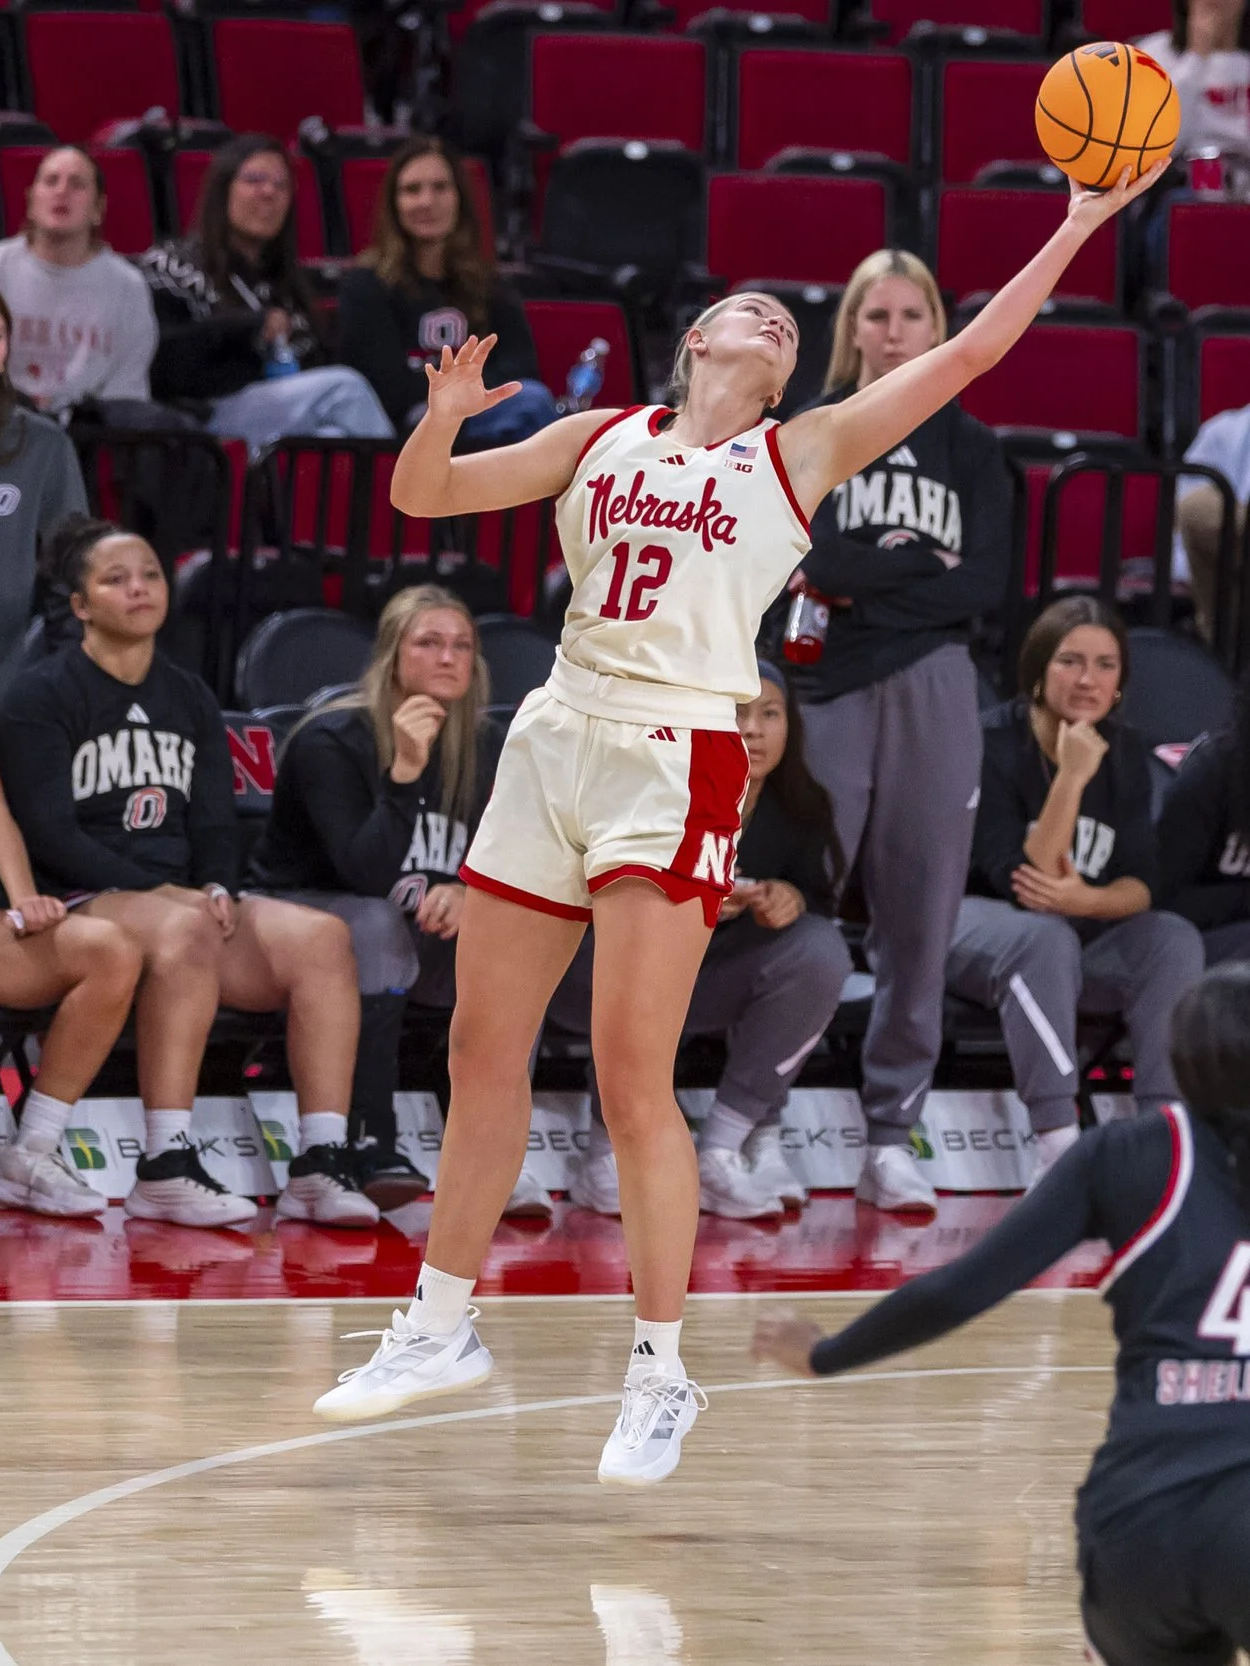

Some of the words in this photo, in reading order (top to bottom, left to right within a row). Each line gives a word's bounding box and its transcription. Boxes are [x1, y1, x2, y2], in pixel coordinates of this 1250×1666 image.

[587, 470, 738, 552] Nebraska
[599, 541, 674, 622] 12
[226, 725, 278, 795] N
[692, 831, 730, 886] N
[117, 1137, 259, 1158] BK'S
[1197, 1240, 1250, 1357] 4
